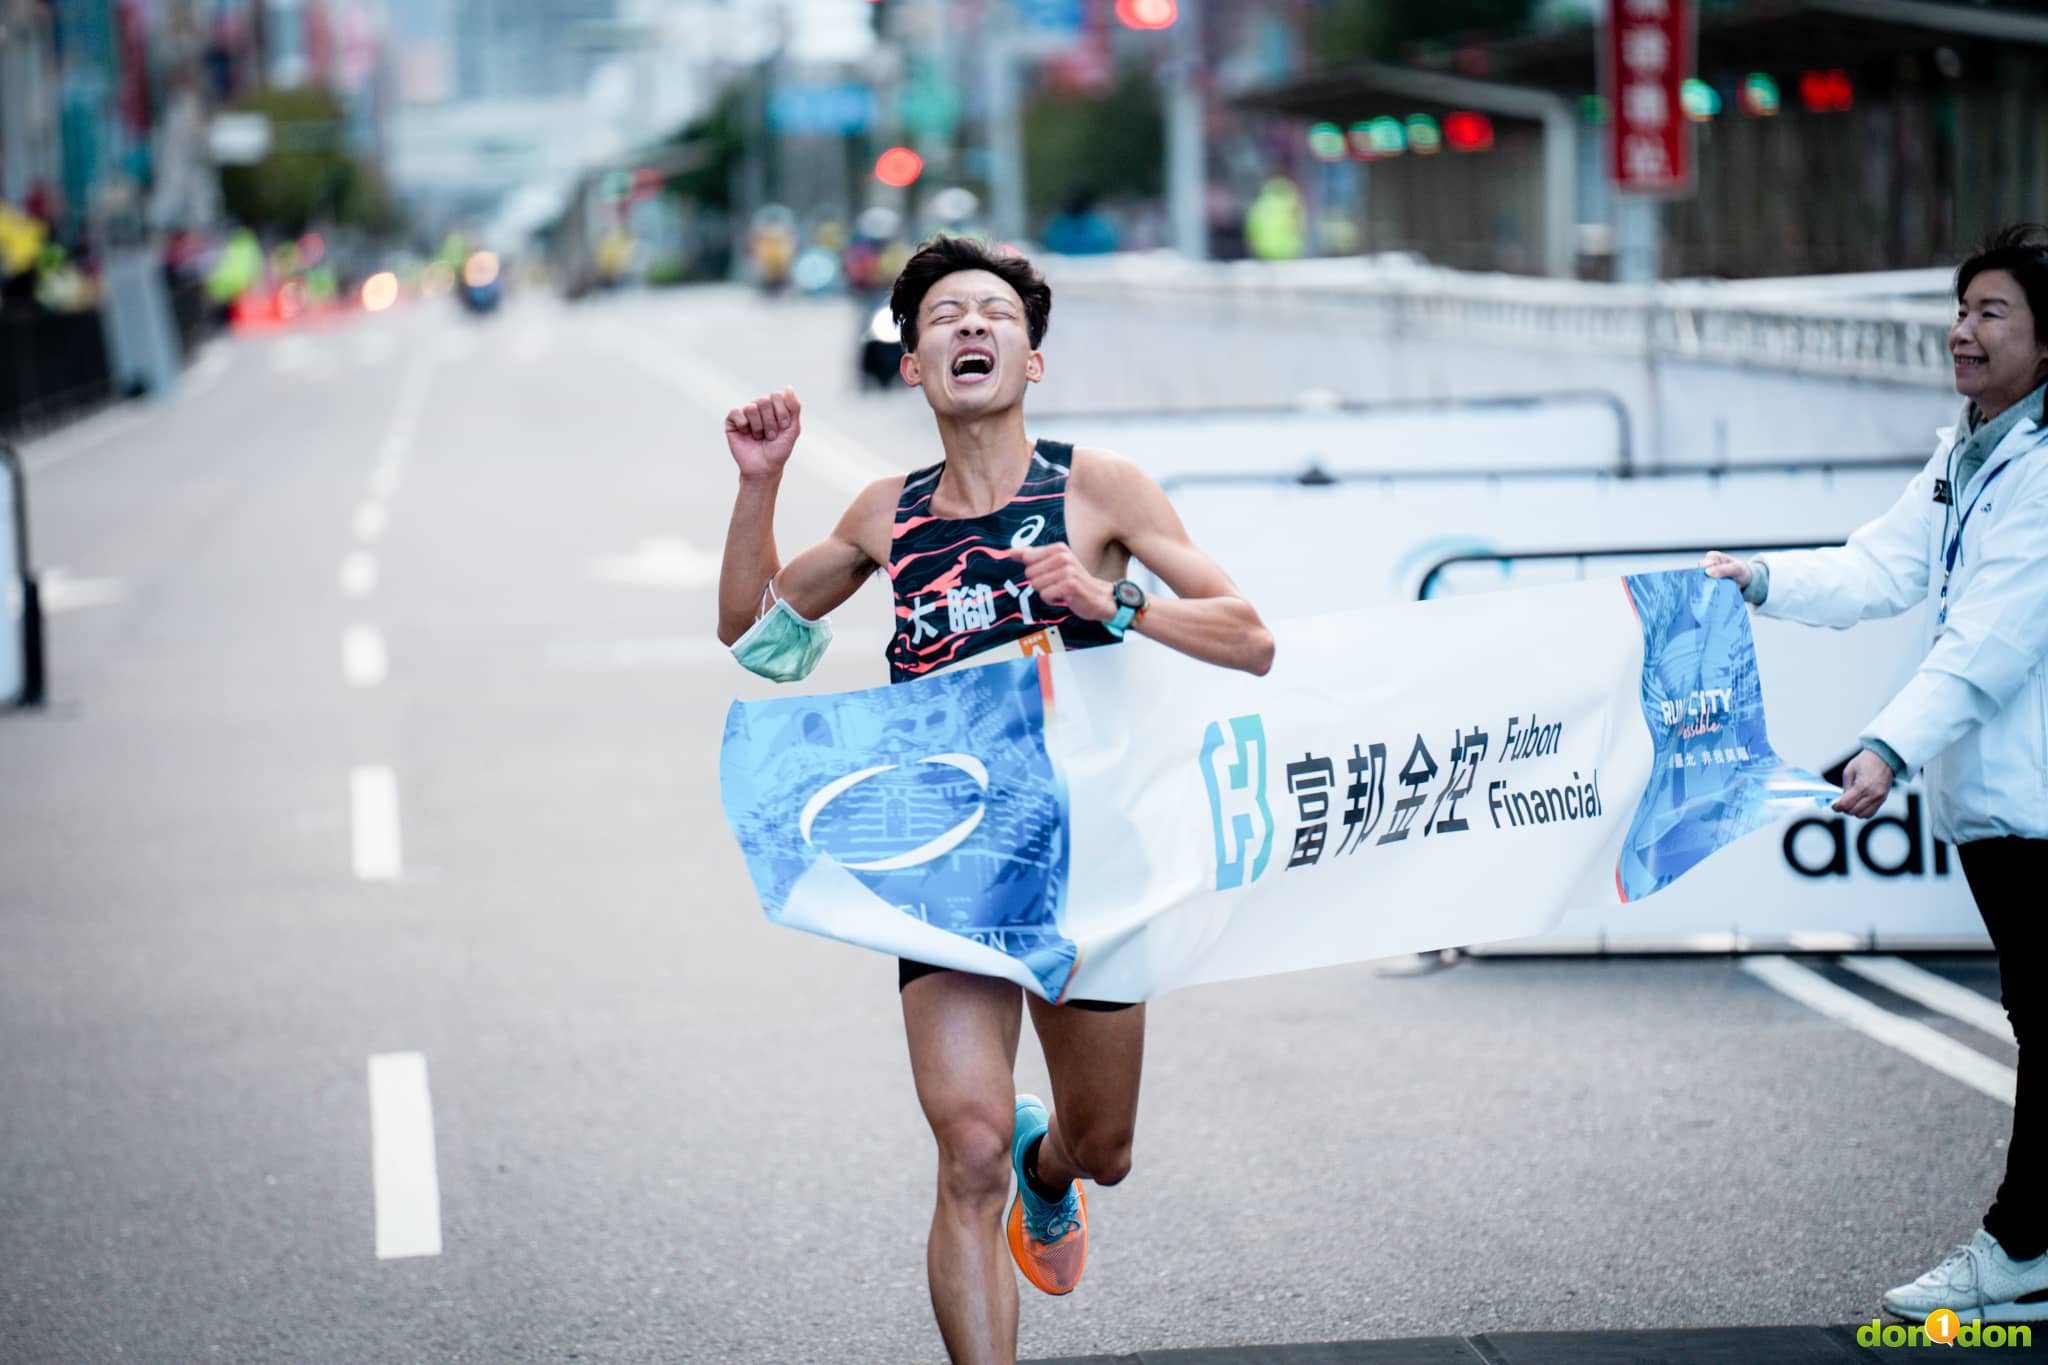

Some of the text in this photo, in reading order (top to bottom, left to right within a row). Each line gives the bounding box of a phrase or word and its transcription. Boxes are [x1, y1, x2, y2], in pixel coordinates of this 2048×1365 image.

[907, 579, 1034, 645] 大腳丫
[1688, 687, 1732, 716] CITY
[1498, 713, 1562, 763] Fubon
[1285, 725, 1489, 872] 富邦金控
[1488, 768, 1602, 829] Financial
